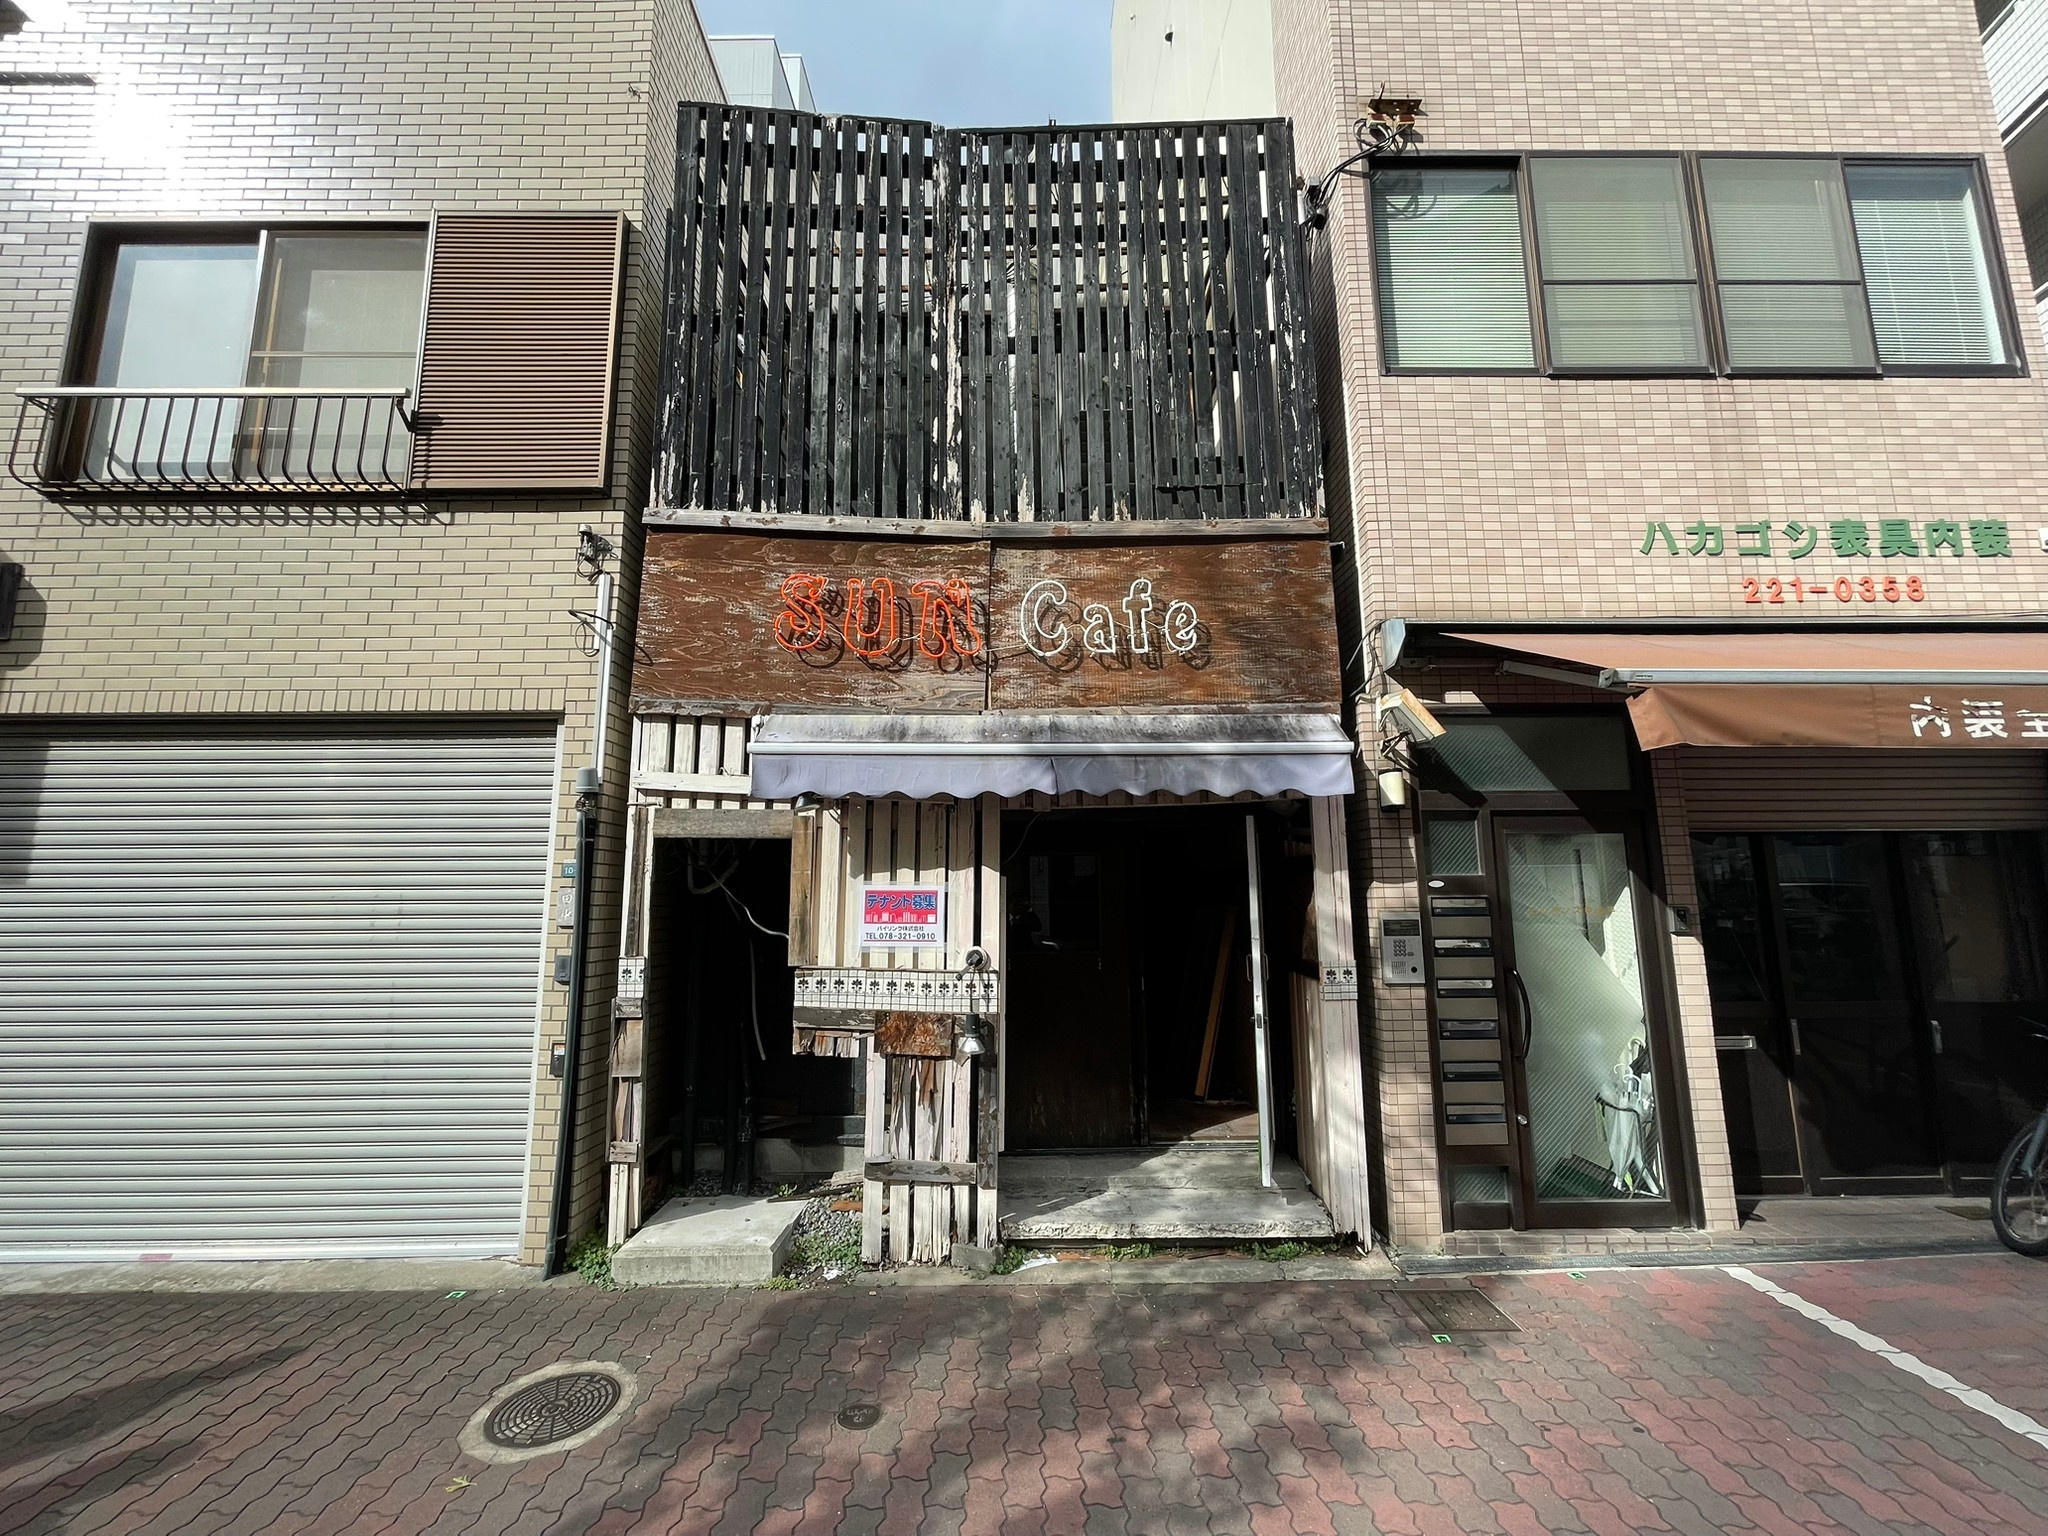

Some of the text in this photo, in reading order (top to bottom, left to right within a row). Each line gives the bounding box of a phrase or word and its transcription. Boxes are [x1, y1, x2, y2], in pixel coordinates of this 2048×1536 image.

[1639, 518, 2012, 559] ハカゴシ表具内装
[1741, 576, 1926, 603] 221-0358
[1020, 577, 1198, 657] Cafe
[866, 893, 937, 909] テナント募集
